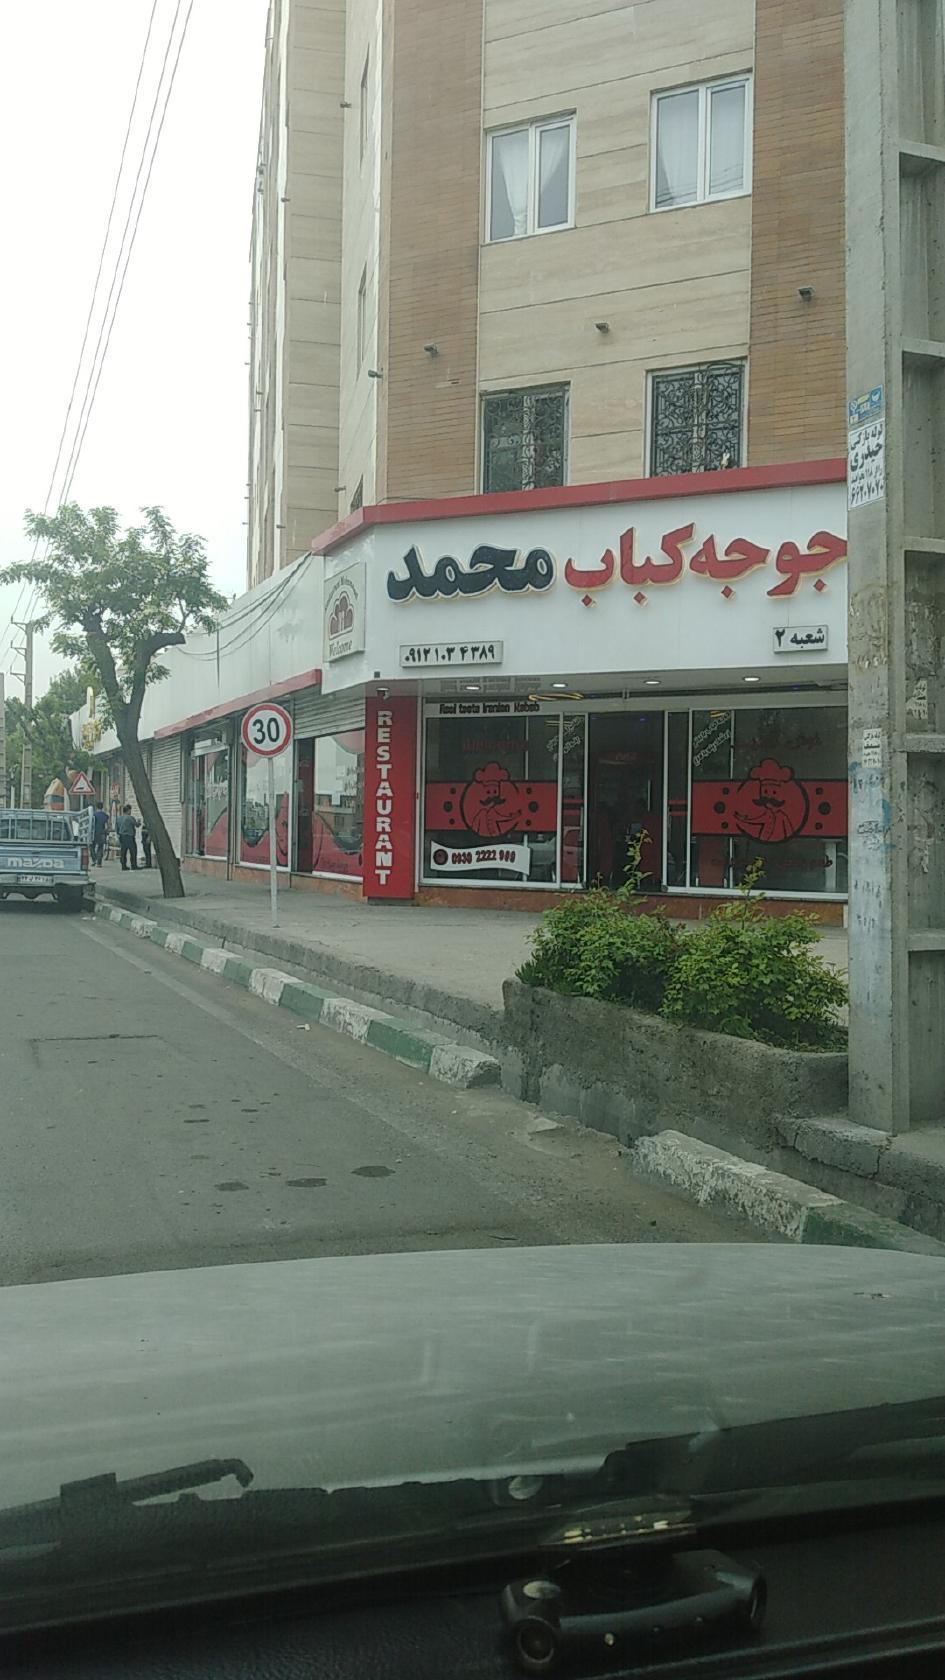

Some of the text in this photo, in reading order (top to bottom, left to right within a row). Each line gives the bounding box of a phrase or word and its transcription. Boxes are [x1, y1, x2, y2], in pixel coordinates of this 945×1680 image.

[850, 442, 883, 472] حیدری
[386, 543, 557, 604] محمد
[563, 522, 696, 608] کباب
[689, 530, 848, 600] جوجه
[775, 628, 825, 649] شعبه ۲
[252, 717, 280, 745] 30
[374, 710, 394, 885] RESTAURANT
[7, 857, 65, 869] mazda
